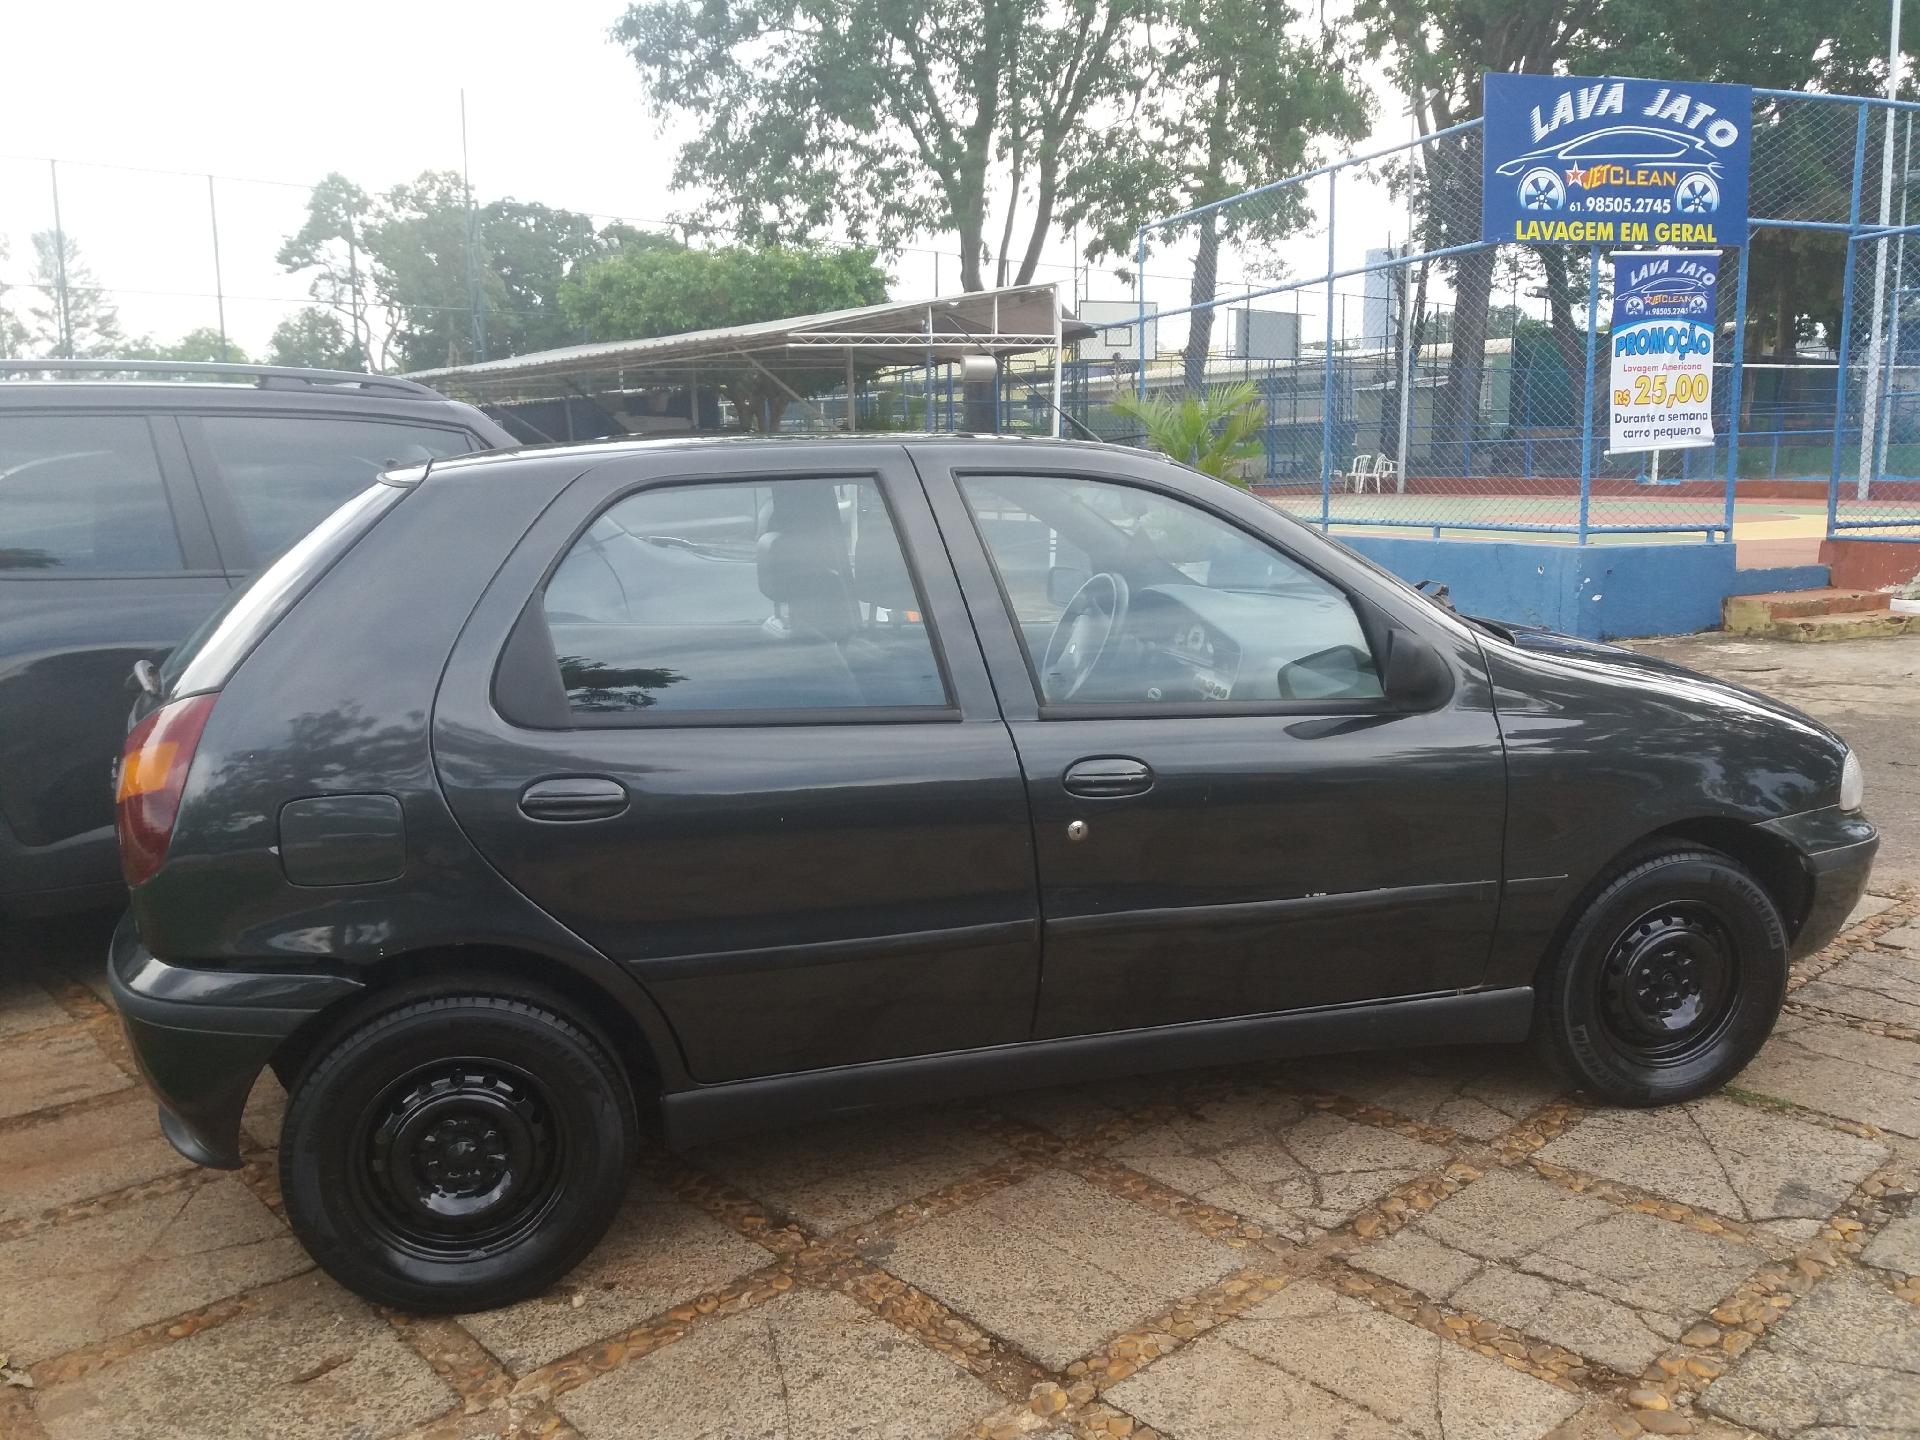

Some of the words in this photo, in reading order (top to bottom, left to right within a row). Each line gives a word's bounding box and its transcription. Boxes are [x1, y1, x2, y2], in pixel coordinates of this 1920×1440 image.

[1529, 83, 1625, 144] LAVA
[1641, 88, 1739, 148] JATO
[1516, 220, 1614, 241] LAVAGEM
[1620, 222, 1649, 242] EM
[1654, 223, 1718, 243] GERAL
[1630, 259, 1669, 287] LAVA
[1676, 260, 1716, 286] JATO
[1615, 323, 1711, 360] PROMOÇÃO
[1623, 363, 1659, 374] Lavagem
[1661, 362, 1702, 372] Americana
[1613, 389, 1631, 407] R$
[1634, 373, 1710, 408] 25,00
[1615, 413, 1656, 424] Durante
[1668, 412, 1708, 422] semana
[1623, 428, 1650, 439] carro
[1653, 427, 1702, 440] pequeno
